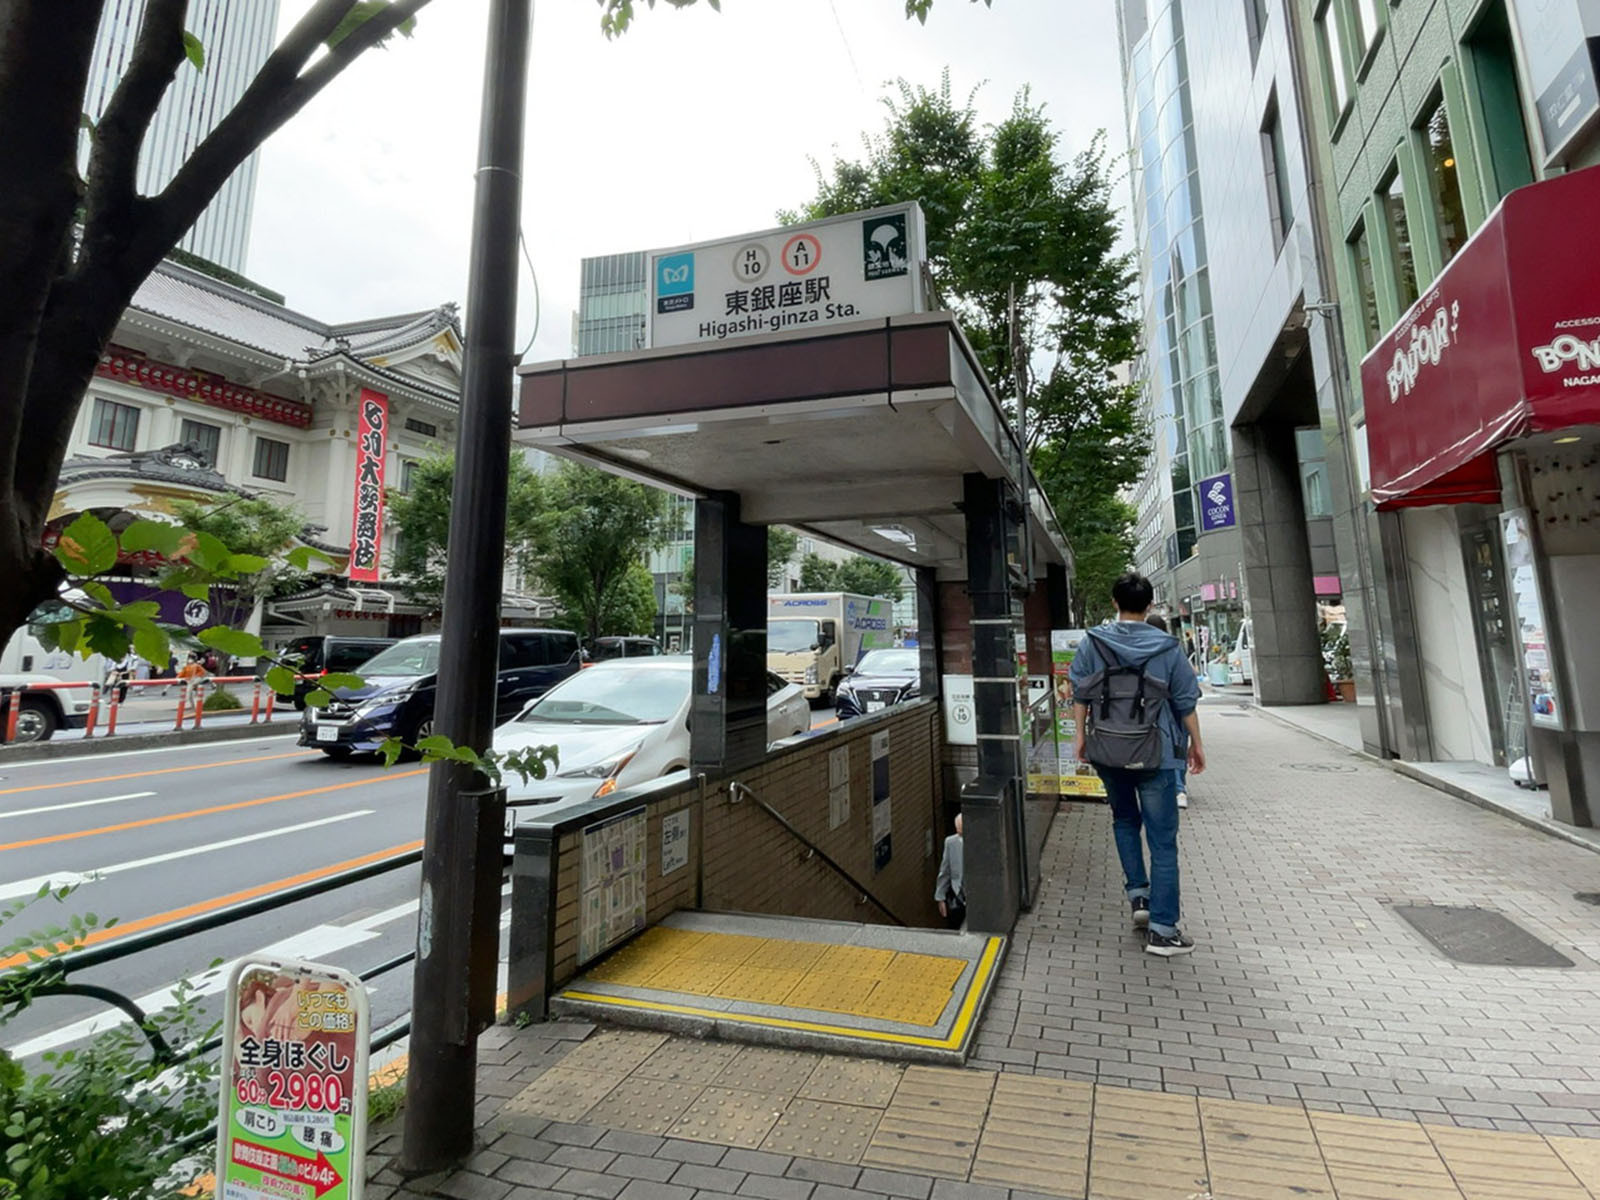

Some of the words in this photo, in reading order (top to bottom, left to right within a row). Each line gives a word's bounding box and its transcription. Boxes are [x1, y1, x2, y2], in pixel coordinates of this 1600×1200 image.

[746, 250, 756, 262] H
[796, 241, 805, 253] A
[793, 254, 809, 266] 11
[743, 263, 761, 276] 10
[725, 276, 830, 316] 東銀座駅
[699, 309, 819, 340] Higashi-ginza
[825, 302, 860, 319] Sta.
[1531, 333, 1600, 373] BON
[1563, 374, 1600, 387] NAGA
[297, 992, 349, 1010] いつでも
[240, 1037, 349, 1072] 全身ほぐし
[244, 1111, 276, 1132] 肩こり
